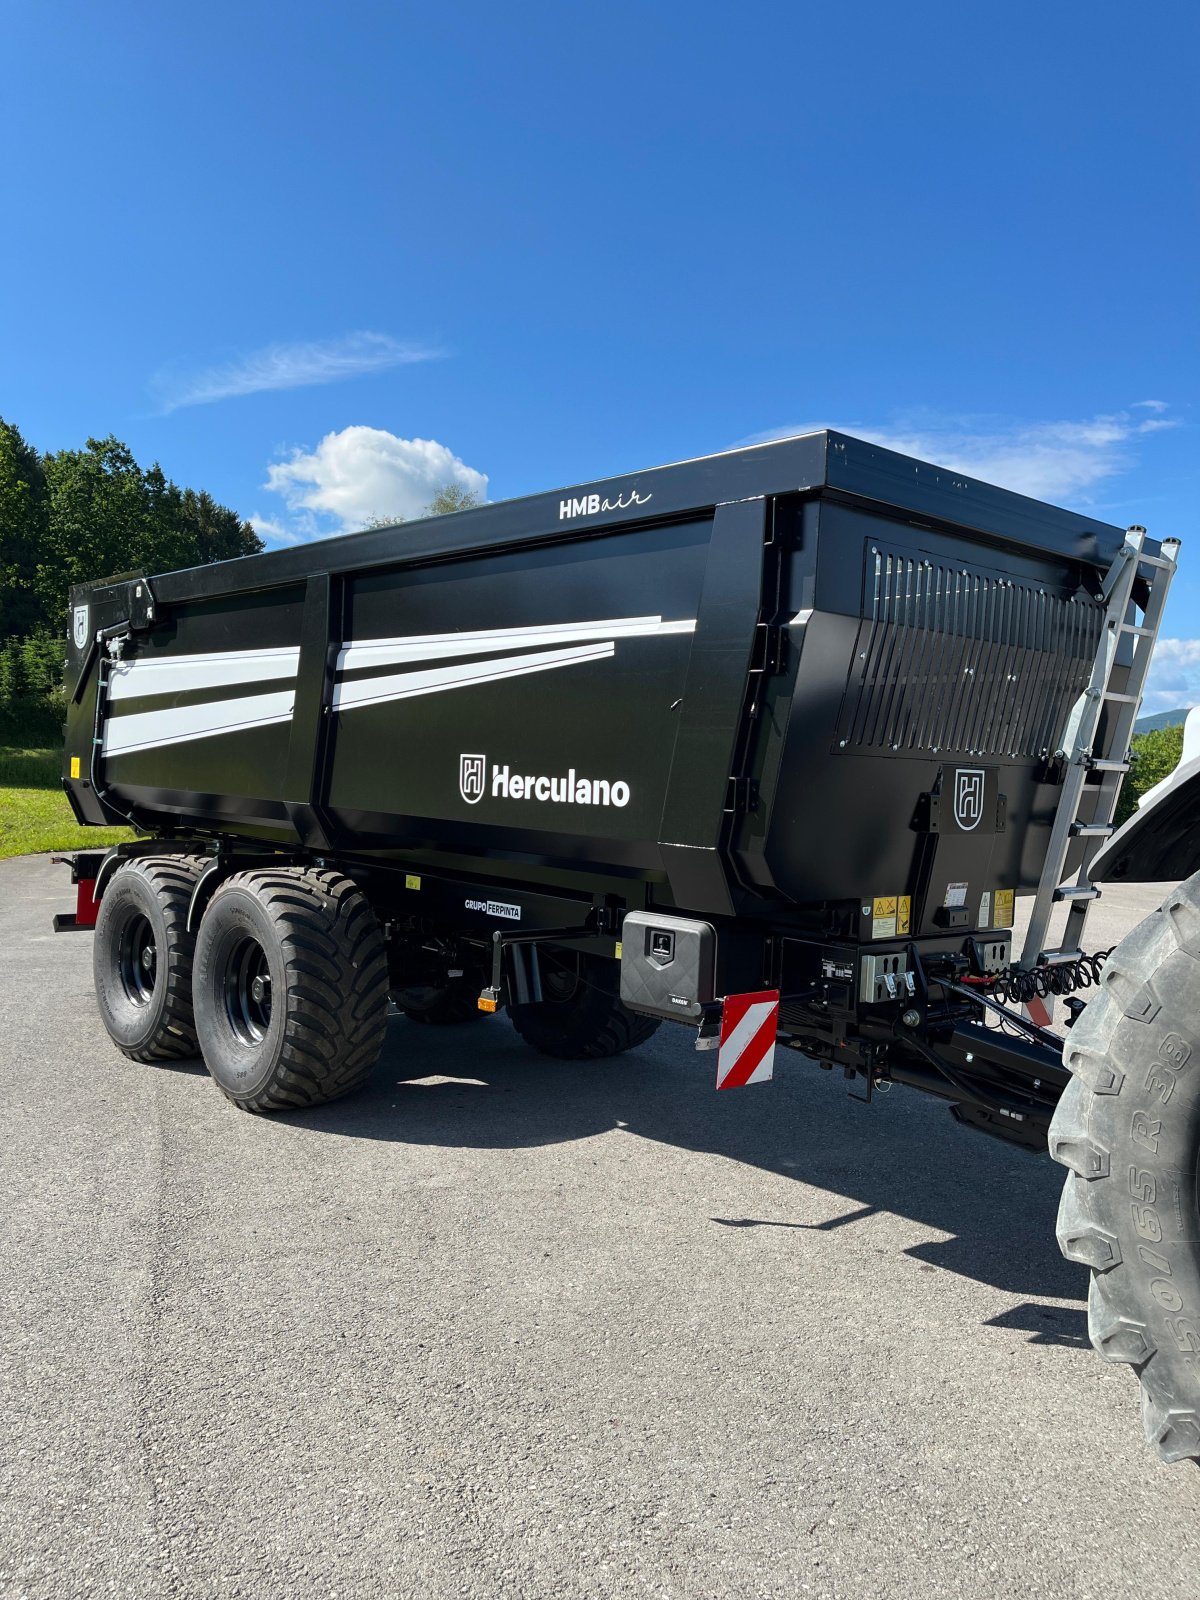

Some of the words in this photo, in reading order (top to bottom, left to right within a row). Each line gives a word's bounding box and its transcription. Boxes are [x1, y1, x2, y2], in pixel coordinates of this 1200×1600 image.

[492, 765, 630, 808] Herculano
[464, 899, 487, 912] GRUPO
[487, 903, 520, 918] FERPINTA
[1144, 1031, 1192, 1105] 38
[1130, 1109, 1162, 1155] R
